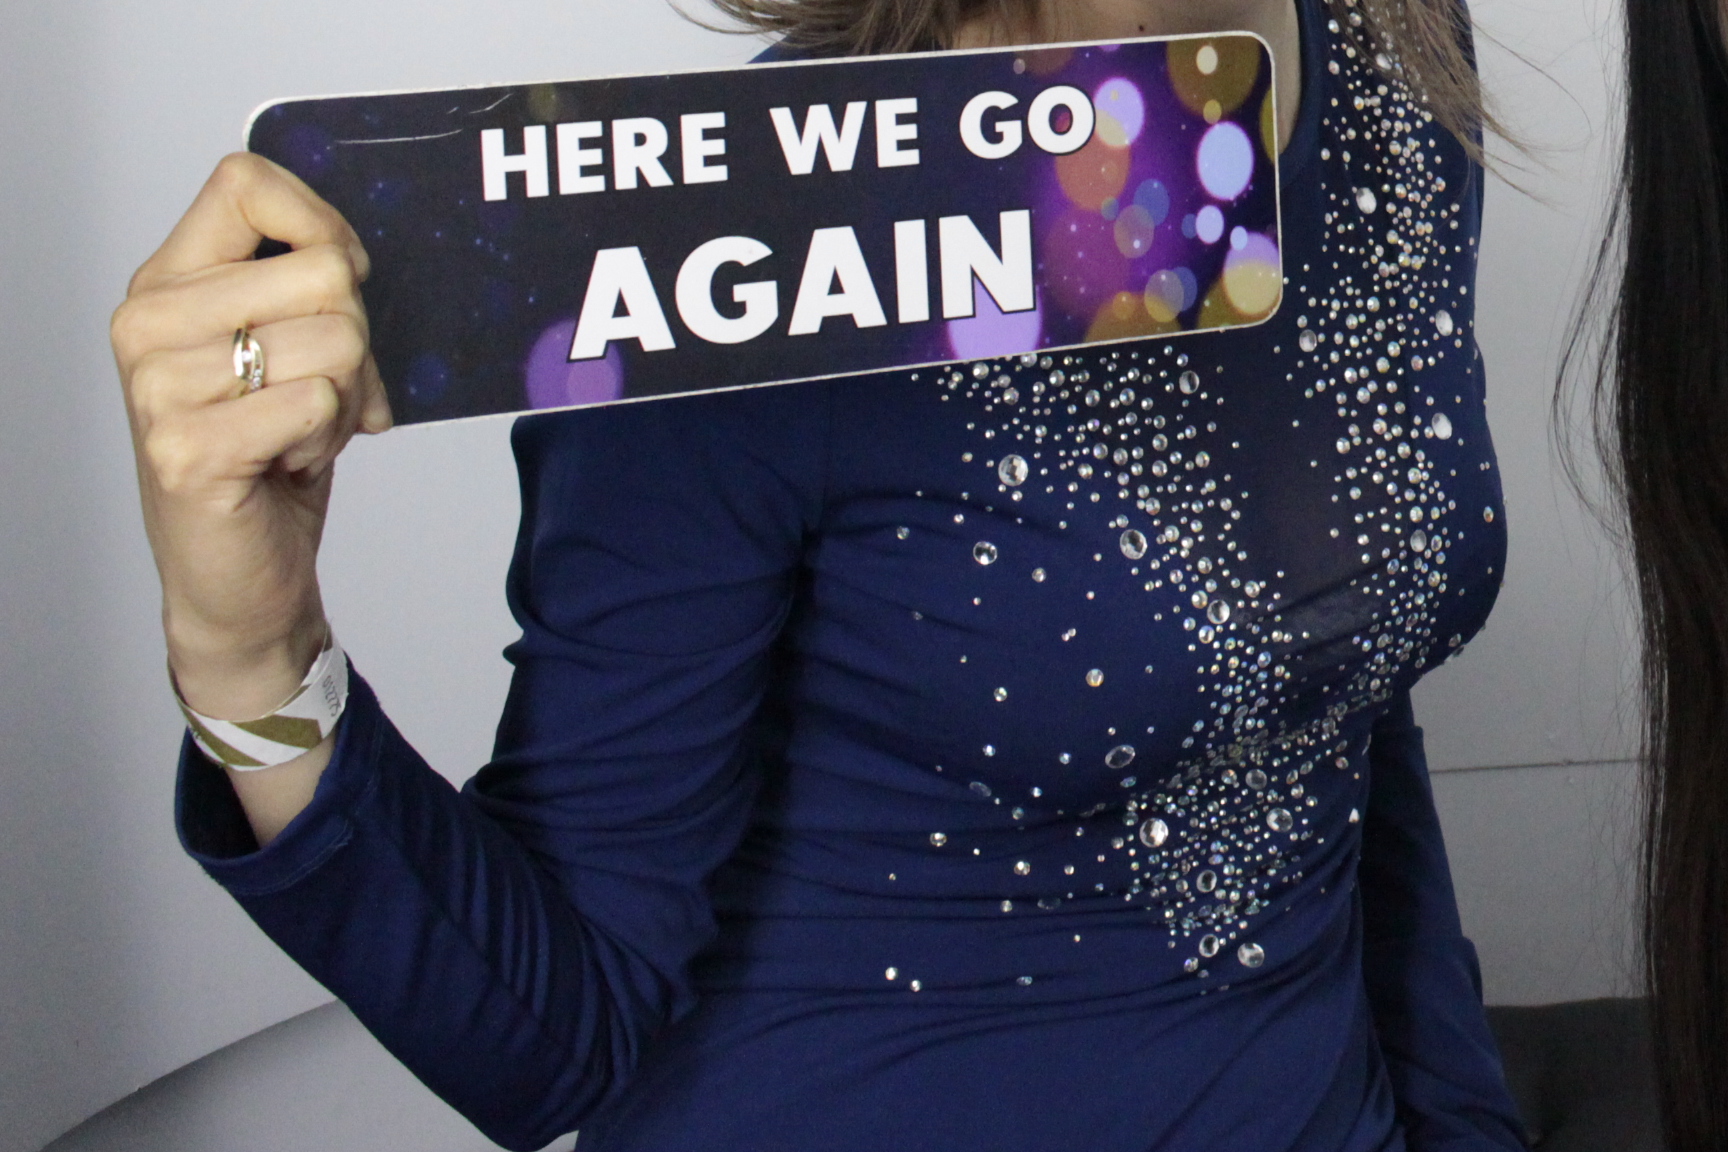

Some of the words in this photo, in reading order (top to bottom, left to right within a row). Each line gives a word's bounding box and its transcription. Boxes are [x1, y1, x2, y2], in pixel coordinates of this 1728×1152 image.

[481, 112, 728, 201] HERE
[769, 97, 920, 175] WE
[959, 85, 1095, 159] GO
[570, 209, 1034, 361] AGAIN
